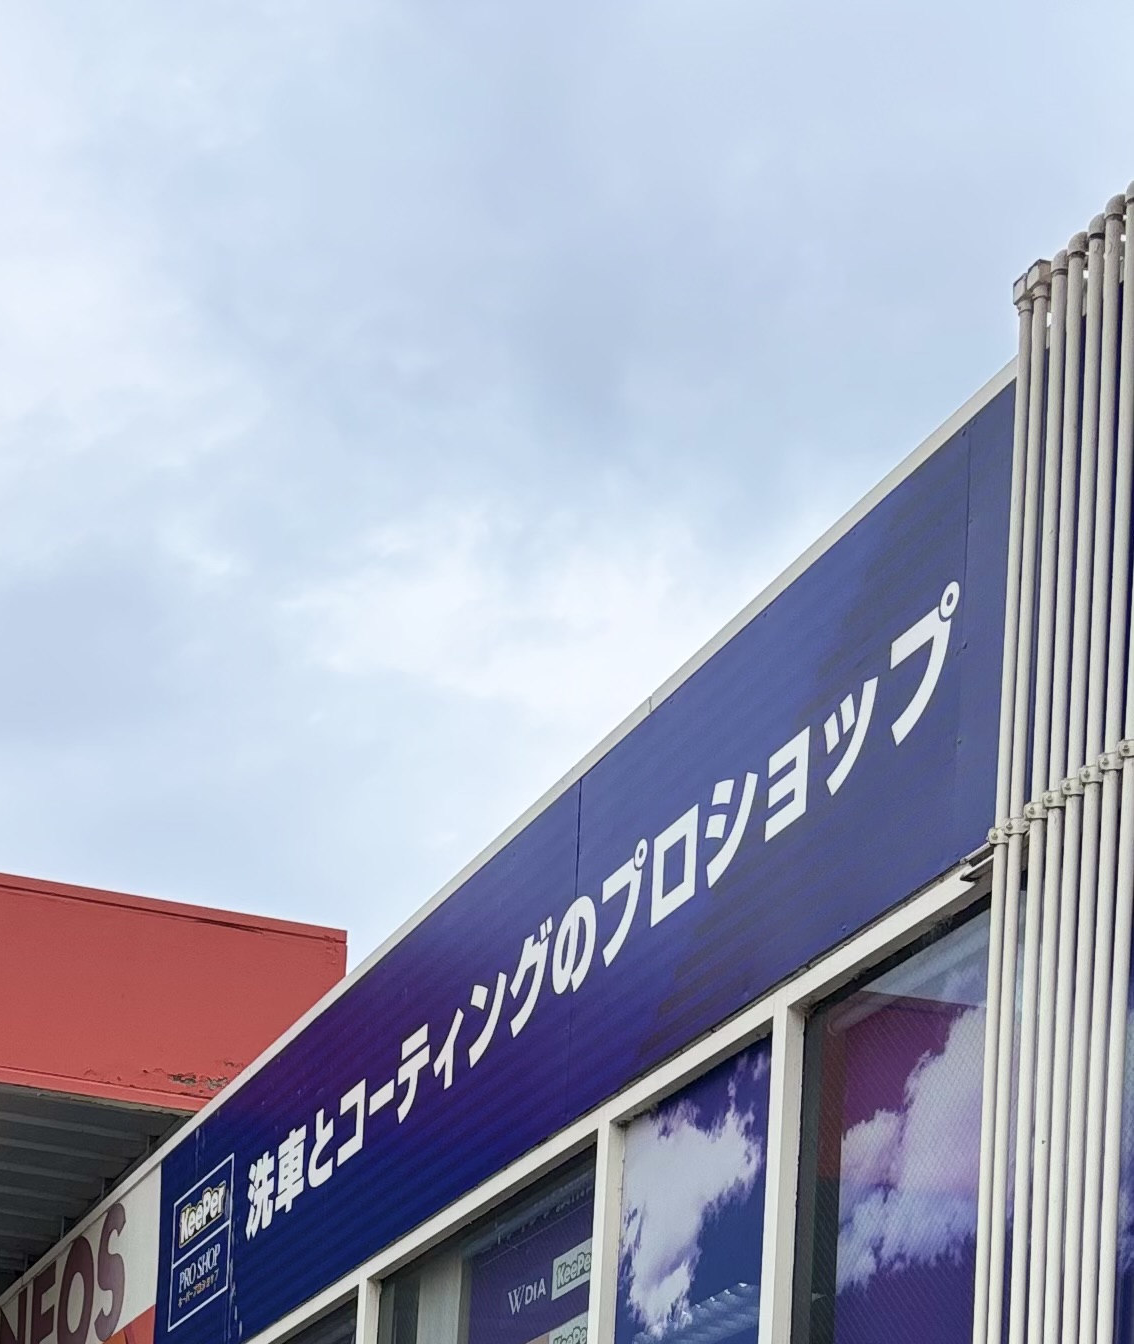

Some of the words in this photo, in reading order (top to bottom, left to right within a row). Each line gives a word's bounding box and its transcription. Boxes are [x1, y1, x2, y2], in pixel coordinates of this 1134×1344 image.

[245, 581, 959, 1241] 洗車とコーティングのプロショップ
[180, 1180, 227, 1249] KeePer
[179, 1263, 198, 1293] PRO
[197, 1243, 220, 1280] SHOP
[556, 1251, 591, 1290] KeePe
